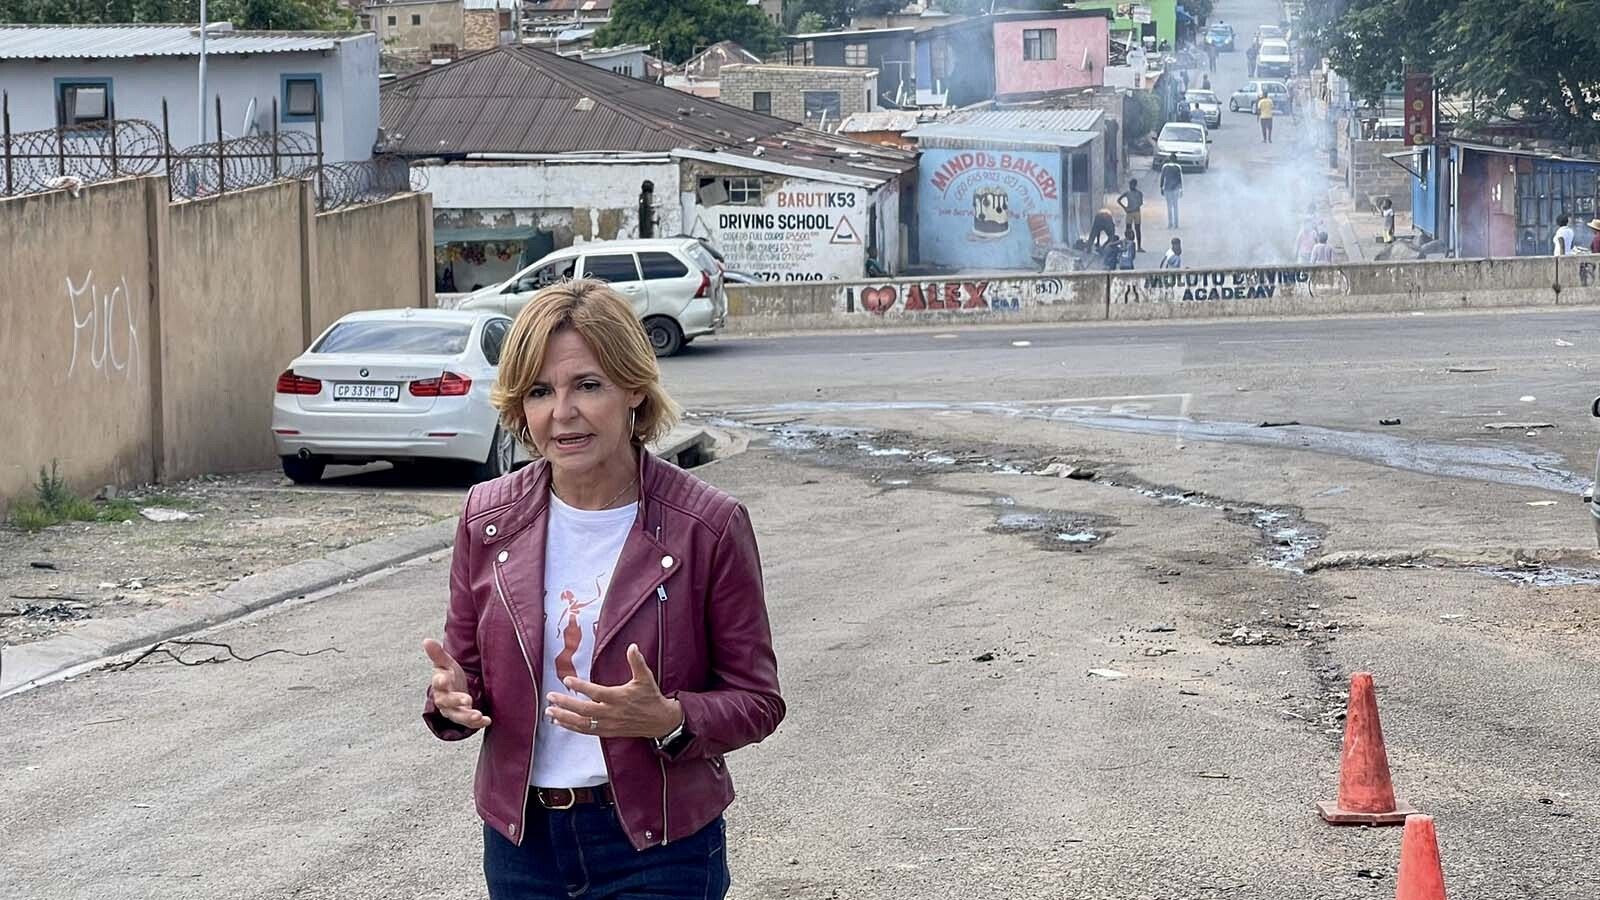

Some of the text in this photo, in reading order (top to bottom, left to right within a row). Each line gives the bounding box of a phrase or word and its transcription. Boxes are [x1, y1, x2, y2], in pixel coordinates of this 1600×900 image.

[1001, 154, 1057, 199] BAKERY
[719, 214, 833, 230] DRIVING SCHOOL
[847, 287, 854, 312] I
[905, 281, 989, 310] ALEX
[1183, 286, 1275, 301] ACADEMY
[338, 385, 395, 397] CP 33 SH GP
